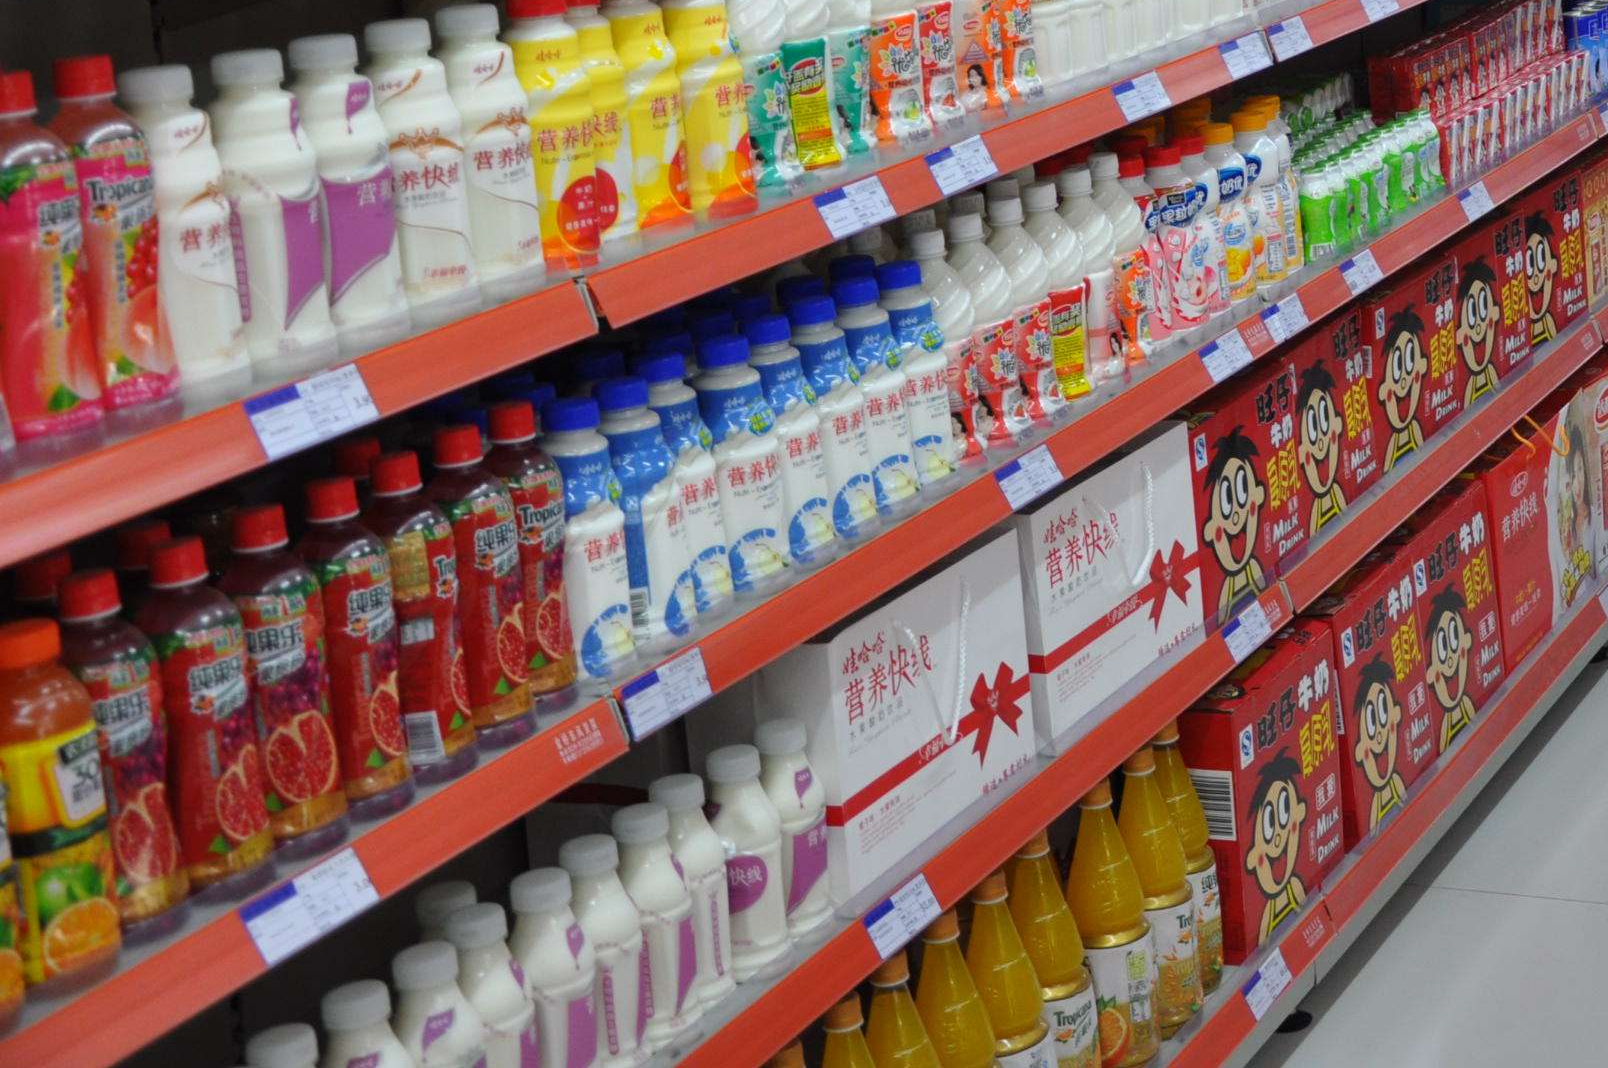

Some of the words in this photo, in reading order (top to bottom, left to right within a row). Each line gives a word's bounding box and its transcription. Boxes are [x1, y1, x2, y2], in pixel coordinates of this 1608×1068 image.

[1563, 206, 1581, 234] 牛奶
[1505, 245, 1523, 275] 牛奶
[1435, 295, 1454, 326] 牛奶
[1345, 352, 1364, 383] 牛奶
[1270, 412, 1294, 446] 牛奶
[1044, 511, 1121, 589] 营养快线
[844, 633, 933, 727] 营养快线
